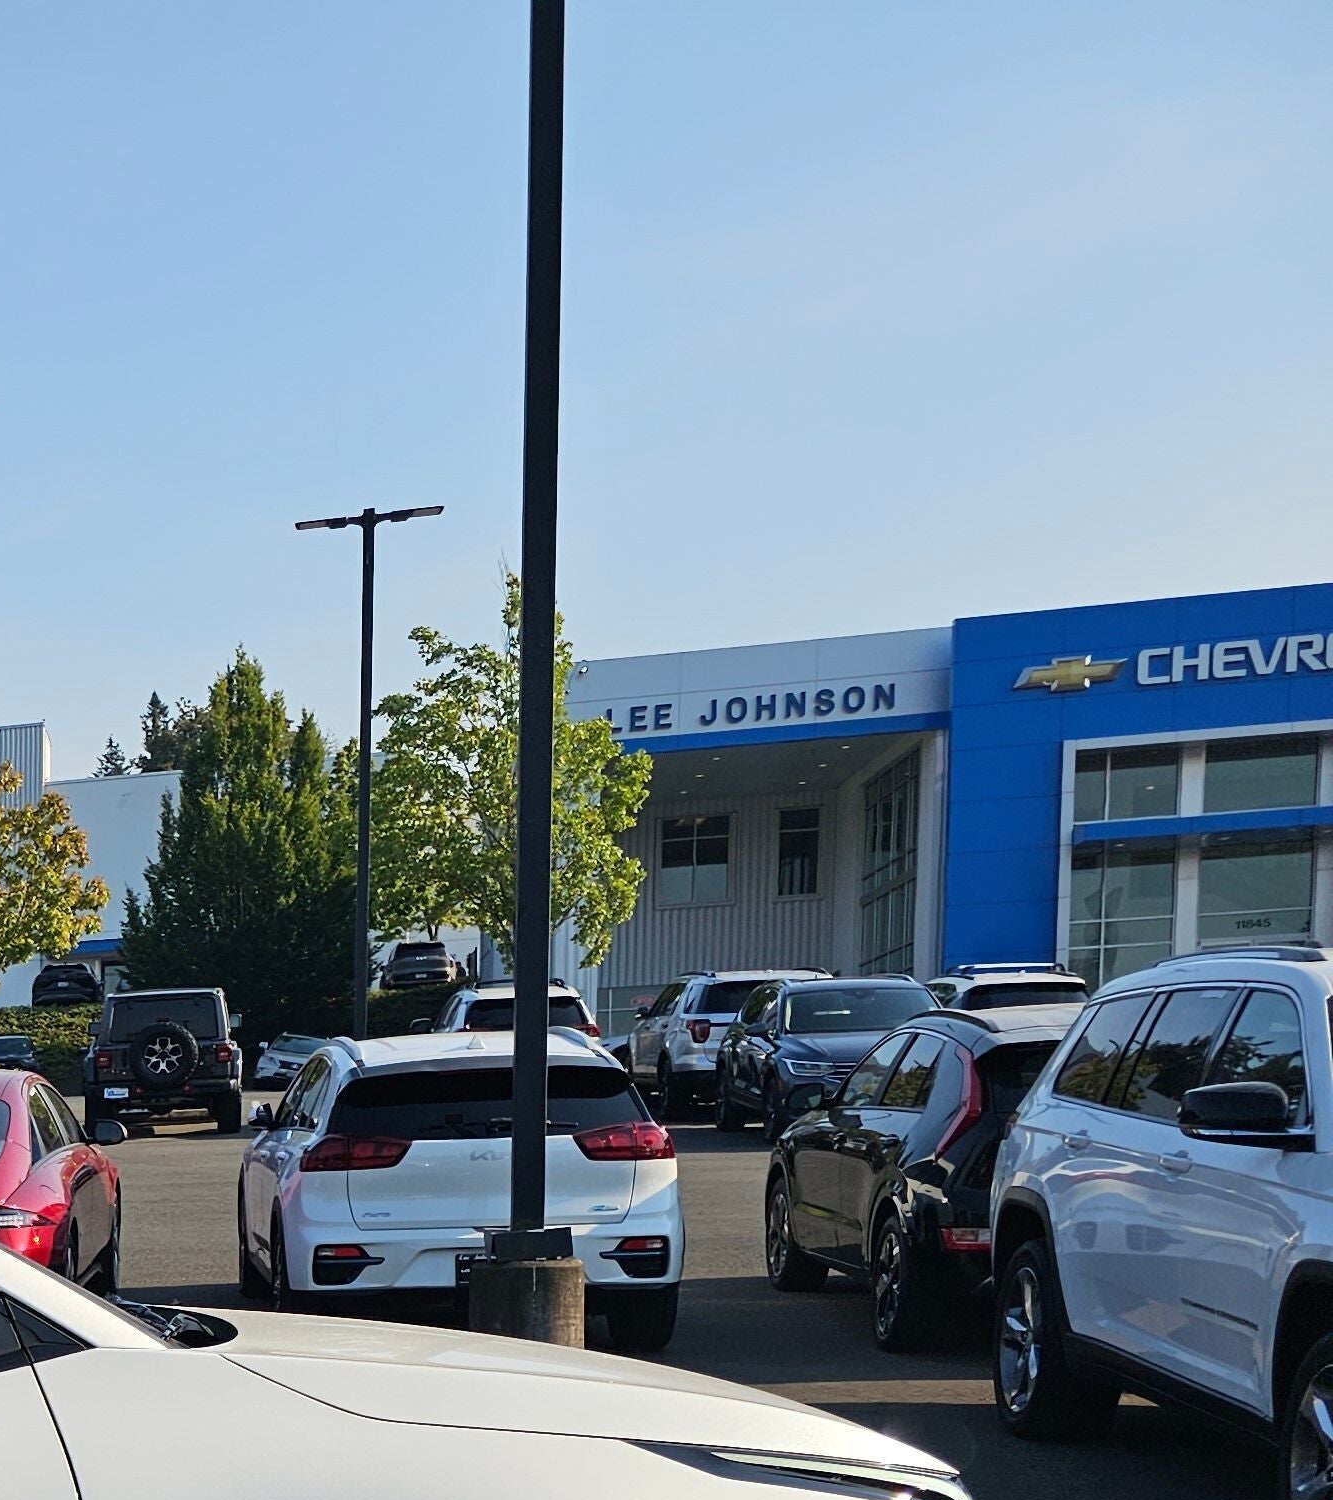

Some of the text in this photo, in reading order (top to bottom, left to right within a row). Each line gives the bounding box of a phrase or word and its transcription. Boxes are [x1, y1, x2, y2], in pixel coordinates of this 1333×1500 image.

[1137, 632, 1333, 686] CHEVR
[605, 682, 896, 733] LEE JOHNSON
[1235, 918, 1272, 930] 11845
